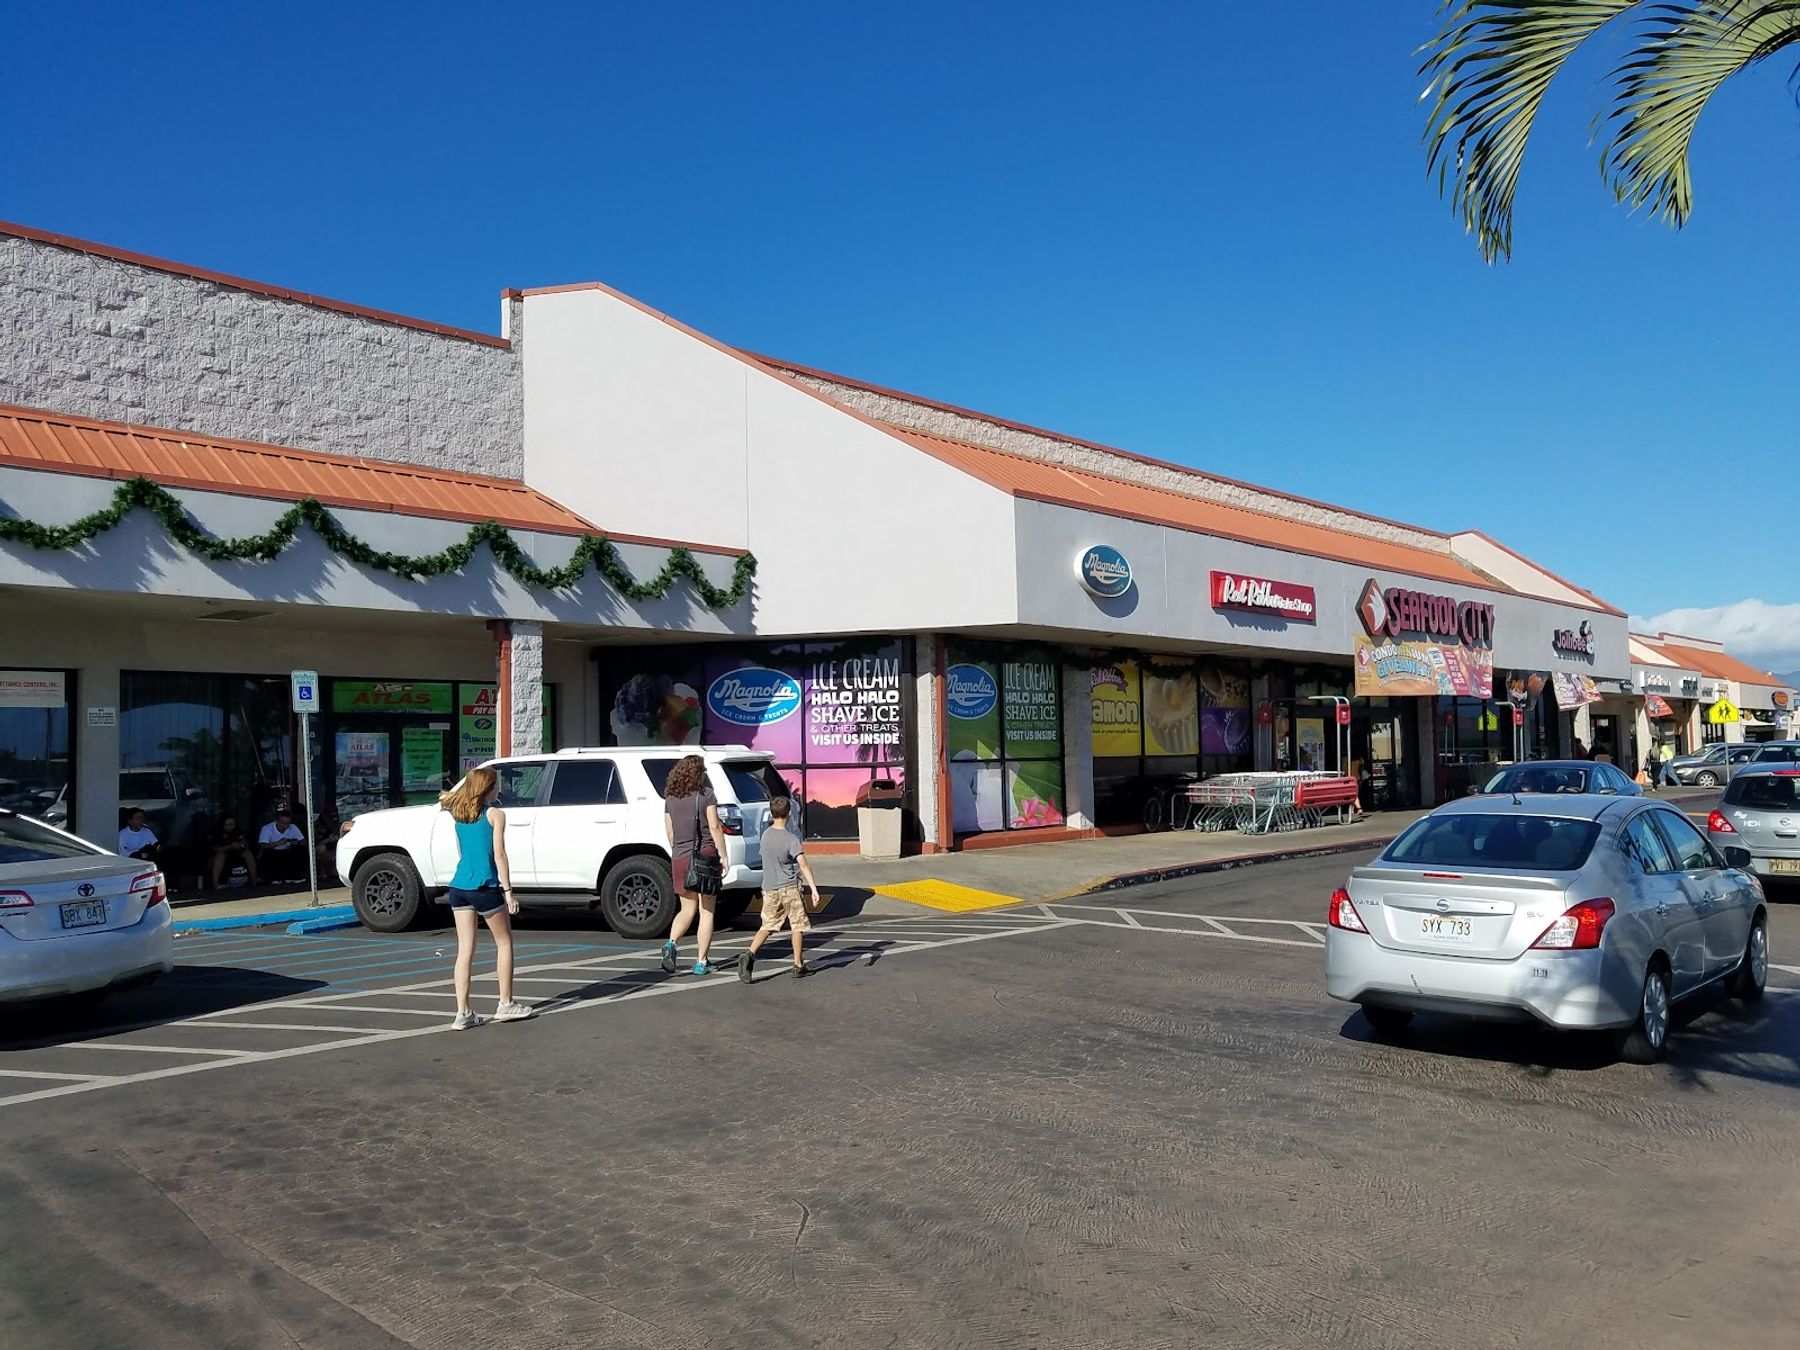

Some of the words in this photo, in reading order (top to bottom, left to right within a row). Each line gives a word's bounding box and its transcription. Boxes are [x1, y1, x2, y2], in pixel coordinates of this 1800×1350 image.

[1085, 553, 1128, 578] Magnolia
[1223, 575, 1247, 603] Red
[1247, 579, 1279, 609] Ribbon
[1387, 587, 1458, 637] SEAFOOD
[1459, 600, 1495, 645] CITY
[1555, 629, 1588, 653] Jollibee
[810, 662, 838, 690] ICE
[842, 658, 899, 690] CREAM
[1004, 662, 1022, 690] ICE
[1023, 662, 1056, 691] CREAM
[354, 692, 430, 704] ATLAS
[715, 679, 798, 704] Magnolia
[811, 692, 853, 705] HALO
[857, 691, 899, 704] HALO
[1005, 692, 1030, 704] HALO
[1032, 692, 1055, 704] HALO
[811, 706, 871, 724] SHAVE
[872, 705, 900, 722] ICE
[1005, 705, 1039, 720] SHAVE
[1040, 705, 1057, 720] ICE
[810, 725, 818, 733] &
[821, 724, 857, 733] OTHER
[860, 723, 899, 732] TREATS
[1005, 730, 1024, 740] VISIT
[1024, 730, 1034, 740] US
[1034, 730, 1057, 740] INSIDE
[351, 743, 375, 751] ATLAS
[811, 734, 842, 745] VISIT
[843, 733, 859, 745] US
[860, 733, 900, 744] INSIDE
[1422, 918, 1442, 933] SYX
[1450, 920, 1471, 936] 733
